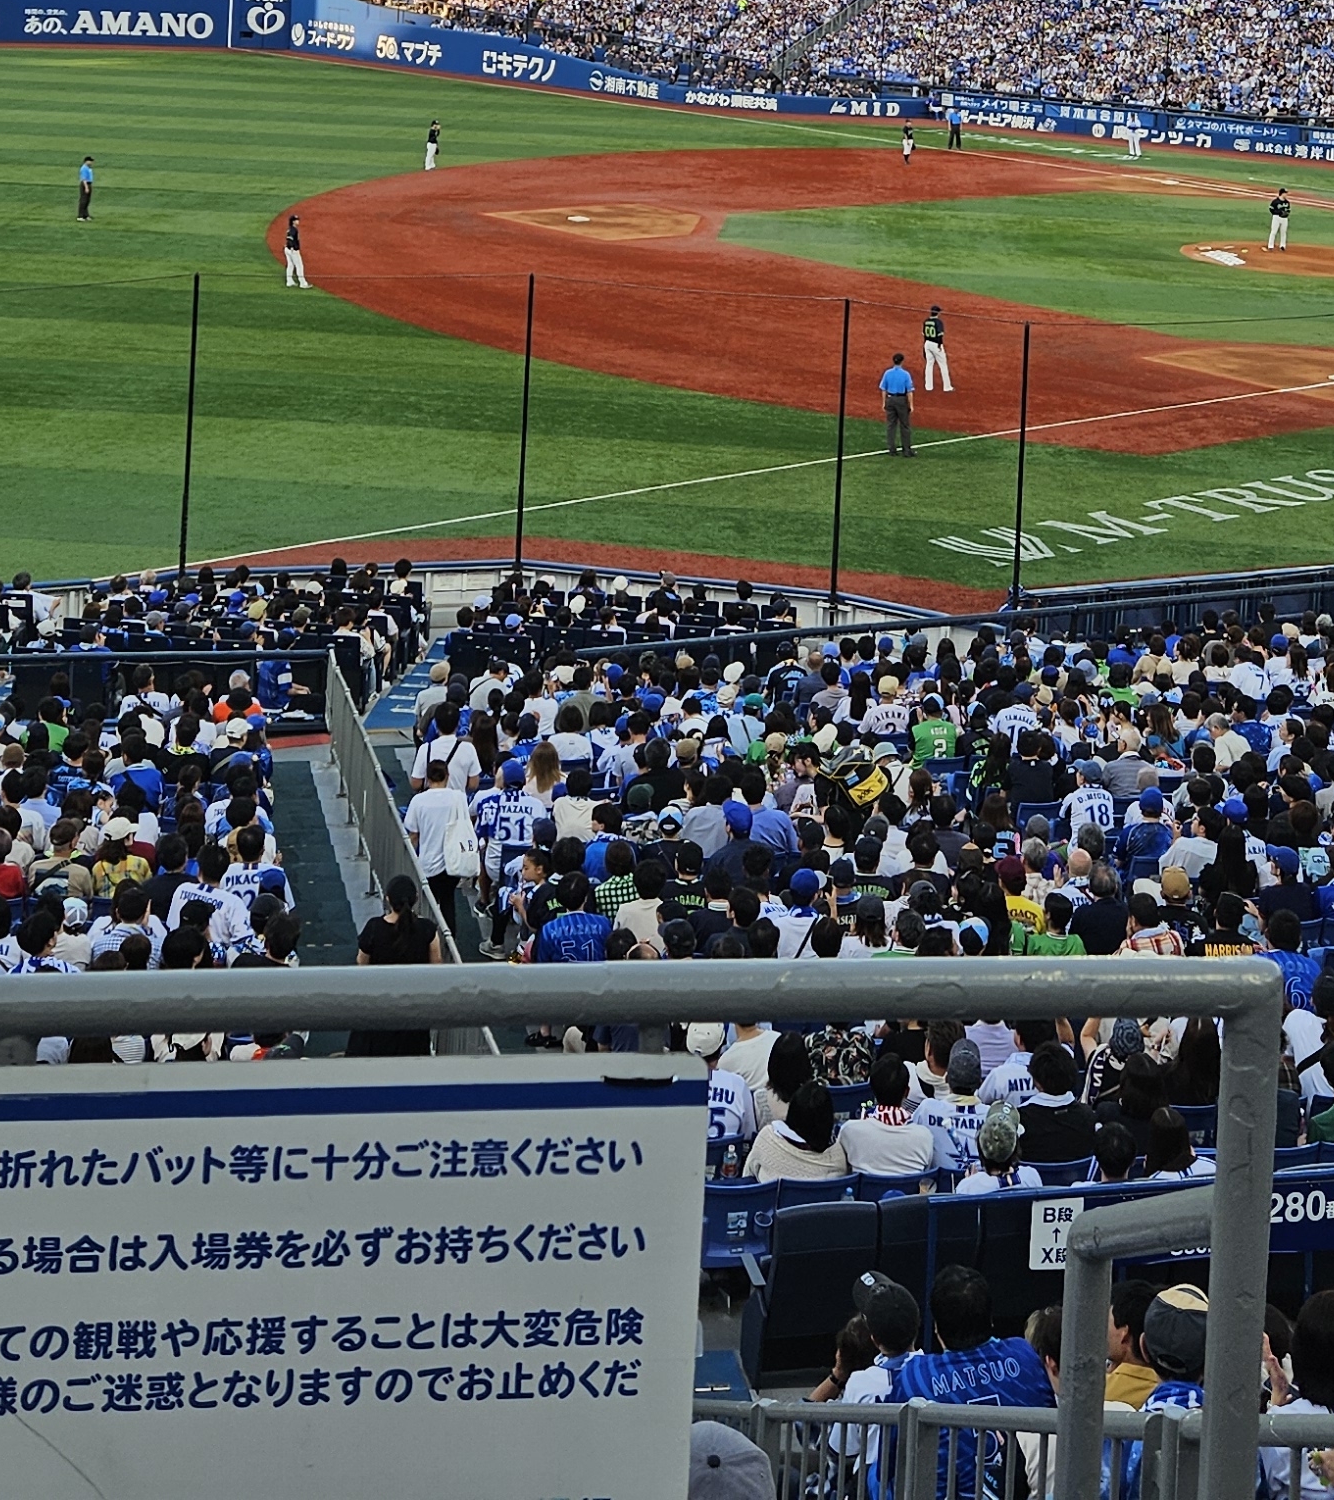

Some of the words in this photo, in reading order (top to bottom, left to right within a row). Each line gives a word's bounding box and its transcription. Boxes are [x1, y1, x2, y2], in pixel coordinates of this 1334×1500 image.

[24, 16, 67, 35] あの、
[72, 10, 213, 38] AMANO
[401, 41, 442, 66] マブチ
[604, 75, 659, 100] 湘南不動産
[850, 101, 900, 117] MID
[981, 100, 1031, 114] メイワ電子
[1255, 143, 1295, 155] 株式会社
[932, 739, 948, 758] 2
[1088, 804, 1109, 826] 18
[495, 816, 527, 840] 51
[1043, 1207, 1073, 1224] B段
[931, 1356, 1020, 1398] MATSUO
